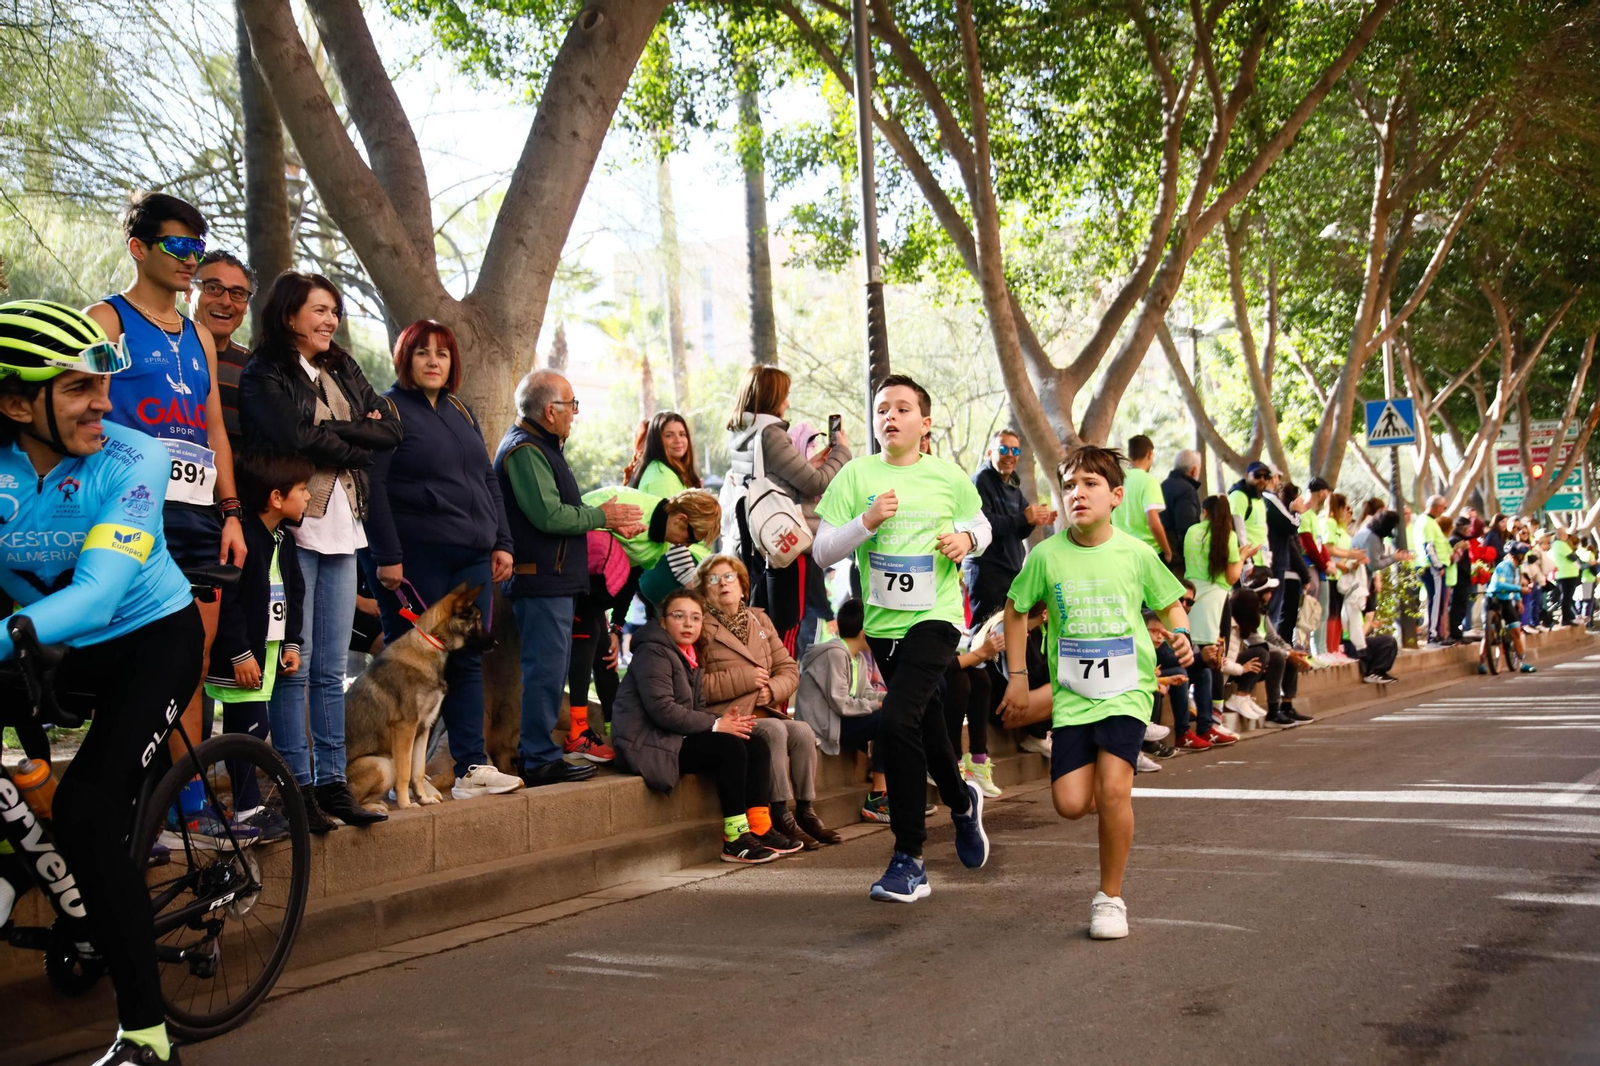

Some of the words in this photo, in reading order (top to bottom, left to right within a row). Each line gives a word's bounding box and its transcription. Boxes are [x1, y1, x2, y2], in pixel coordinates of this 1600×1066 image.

[109, 439, 144, 463] REALE
[170, 460, 206, 487] 691
[880, 519, 922, 530] contra
[925, 518, 936, 530] el
[6, 549, 79, 563] ALMERÍA
[111, 541, 144, 559] Europack
[884, 572, 914, 593] 79
[1065, 595, 1080, 606] En
[1082, 594, 1127, 605] marcha
[1068, 606, 1111, 619] contra
[1114, 605, 1128, 617] el
[1067, 620, 1129, 635] cáncer
[1079, 658, 1110, 680] 71
